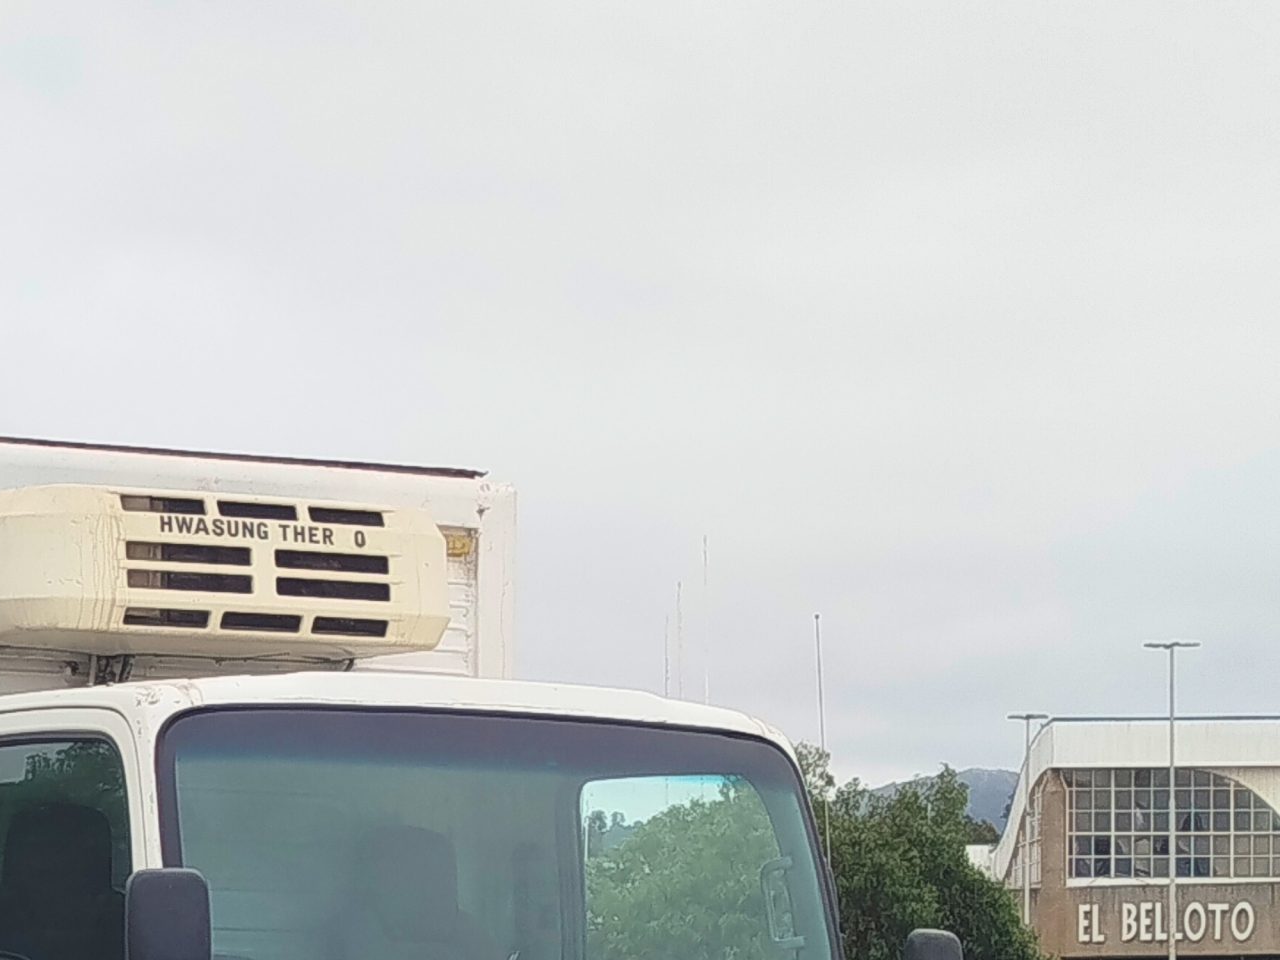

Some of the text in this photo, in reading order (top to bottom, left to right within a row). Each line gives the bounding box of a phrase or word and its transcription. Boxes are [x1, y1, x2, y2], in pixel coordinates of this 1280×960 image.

[159, 515, 269, 541] HWASUNG
[278, 524, 335, 546] THER
[1078, 903, 1105, 943] EL
